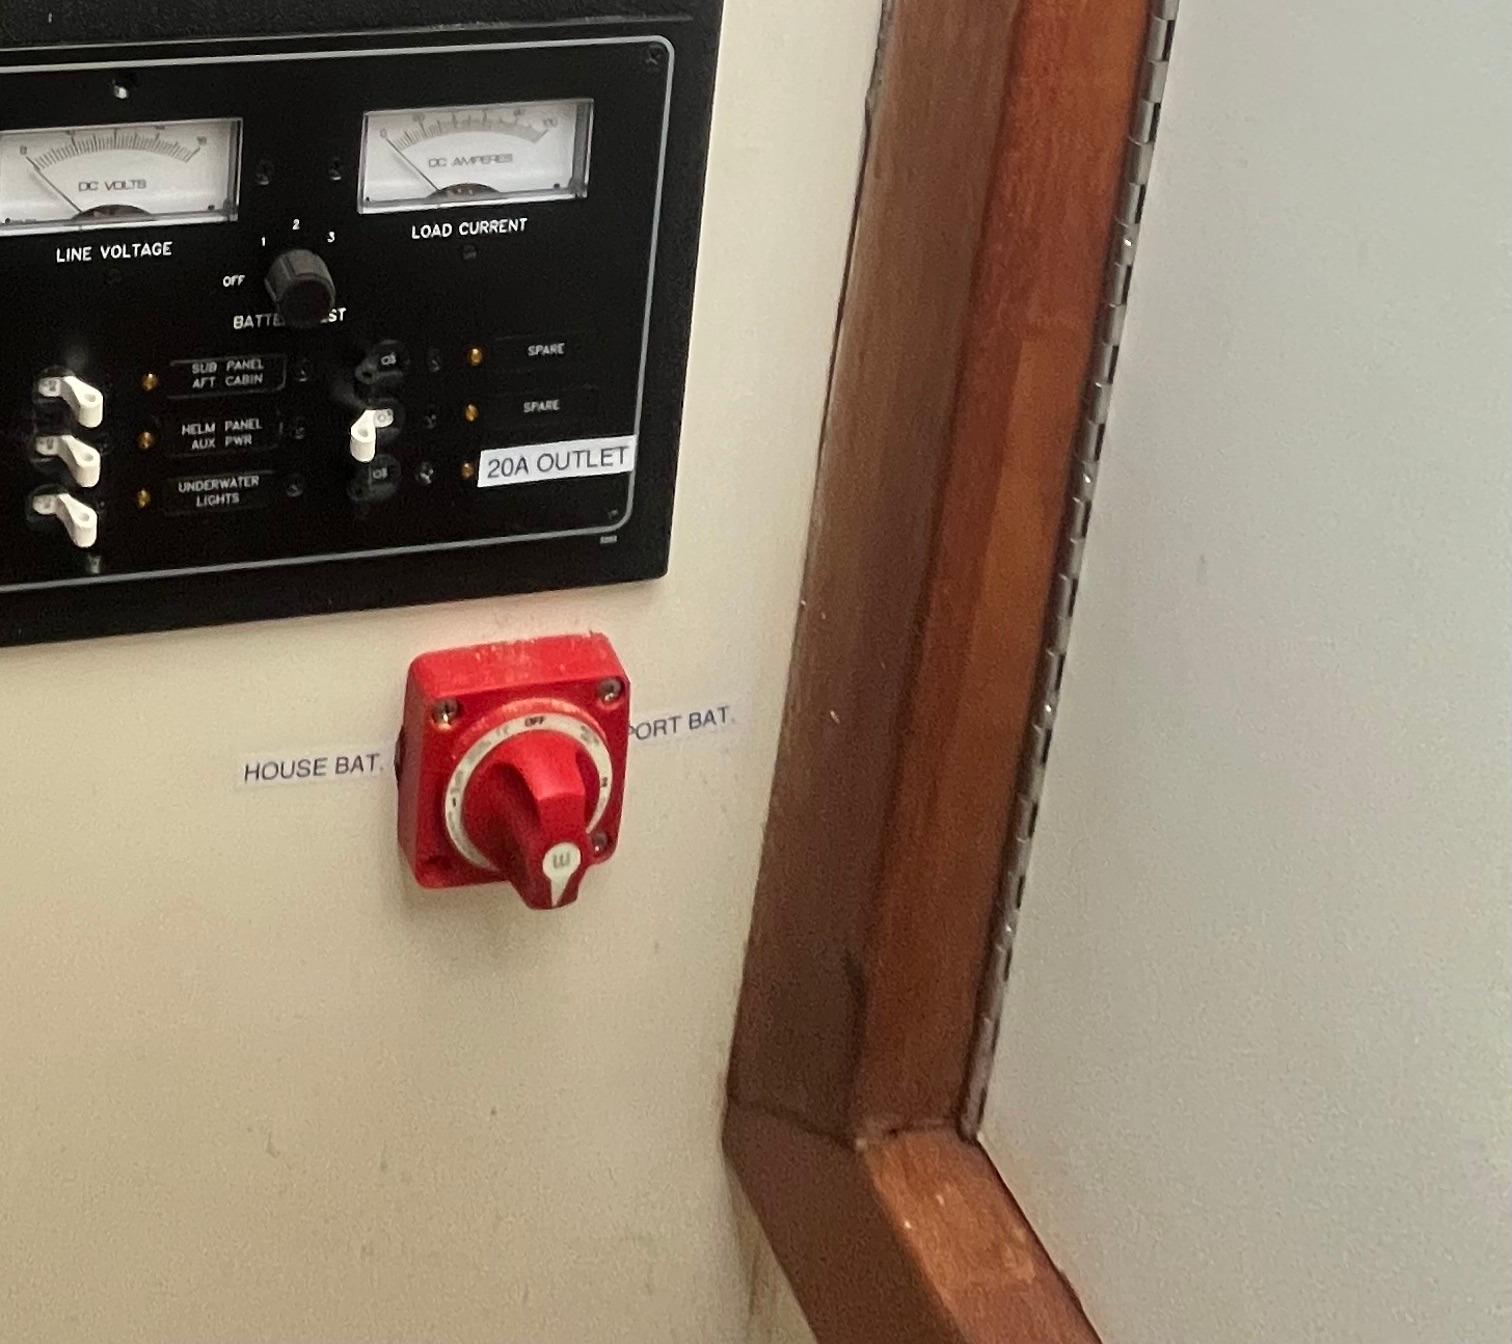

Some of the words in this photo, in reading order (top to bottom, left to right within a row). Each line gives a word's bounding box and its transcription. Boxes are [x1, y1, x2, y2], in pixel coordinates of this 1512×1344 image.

[78, 181, 99, 192] DC
[292, 218, 300, 230] 2
[411, 223, 453, 240] LOAD
[459, 217, 528, 237] CURRENT
[327, 231, 335, 243] 3
[56, 246, 93, 263] LINE
[100, 240, 173, 260] VOLTAGE
[222, 274, 246, 288] OFF
[527, 342, 565, 357] SPARE
[191, 362, 217, 376] SUB
[226, 358, 265, 372] PANEL
[192, 376, 216, 390] AFT
[225, 373, 264, 388] CABIN
[523, 399, 561, 413] SPARE
[181, 421, 216, 436] HELM
[224, 418, 263, 432] PANEL
[191, 437, 216, 450] AUX
[224, 433, 253, 448] PWR
[486, 456, 530, 480] 20A
[536, 444, 629, 474] OUTLET
[178, 474, 260, 494] UNDERWATER
[196, 492, 240, 508] LIGHTS
[687, 705, 737, 733] BAT.
[243, 756, 328, 784] HOUSE
[334, 752, 385, 776] BAT.
